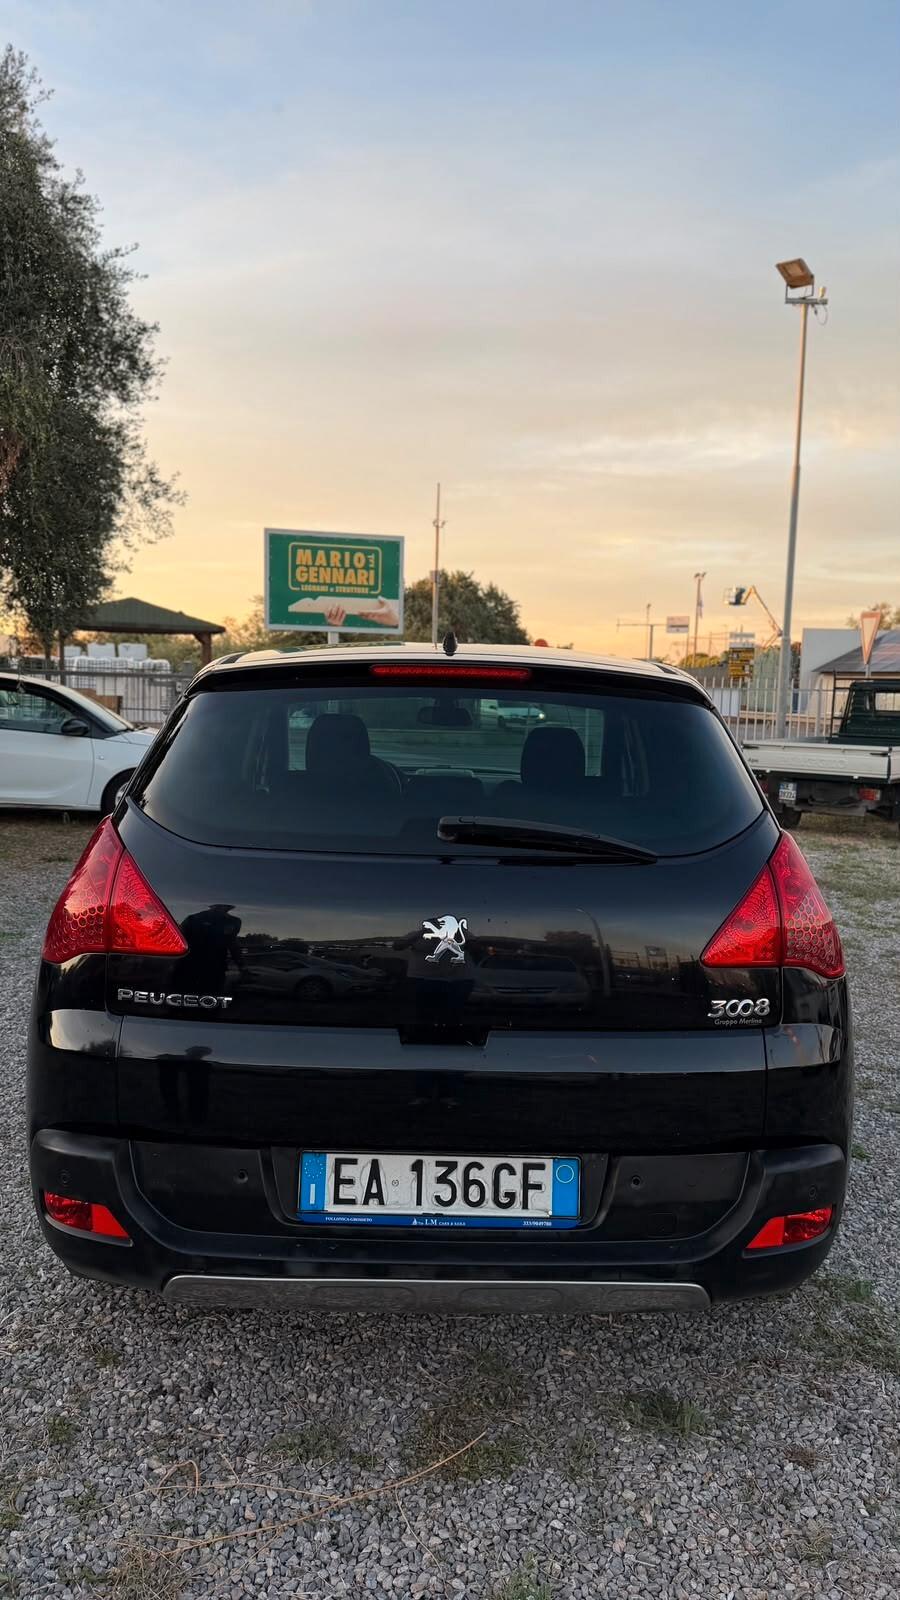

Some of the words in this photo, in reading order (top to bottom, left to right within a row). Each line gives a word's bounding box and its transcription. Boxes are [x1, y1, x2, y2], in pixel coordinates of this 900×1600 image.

[295, 549, 366, 568] MARIO
[295, 566, 375, 586] GENNARI
[117, 988, 233, 1008] PEUGEOT
[707, 998, 770, 1017] 3008
[714, 1019, 738, 1027] Gruppo
